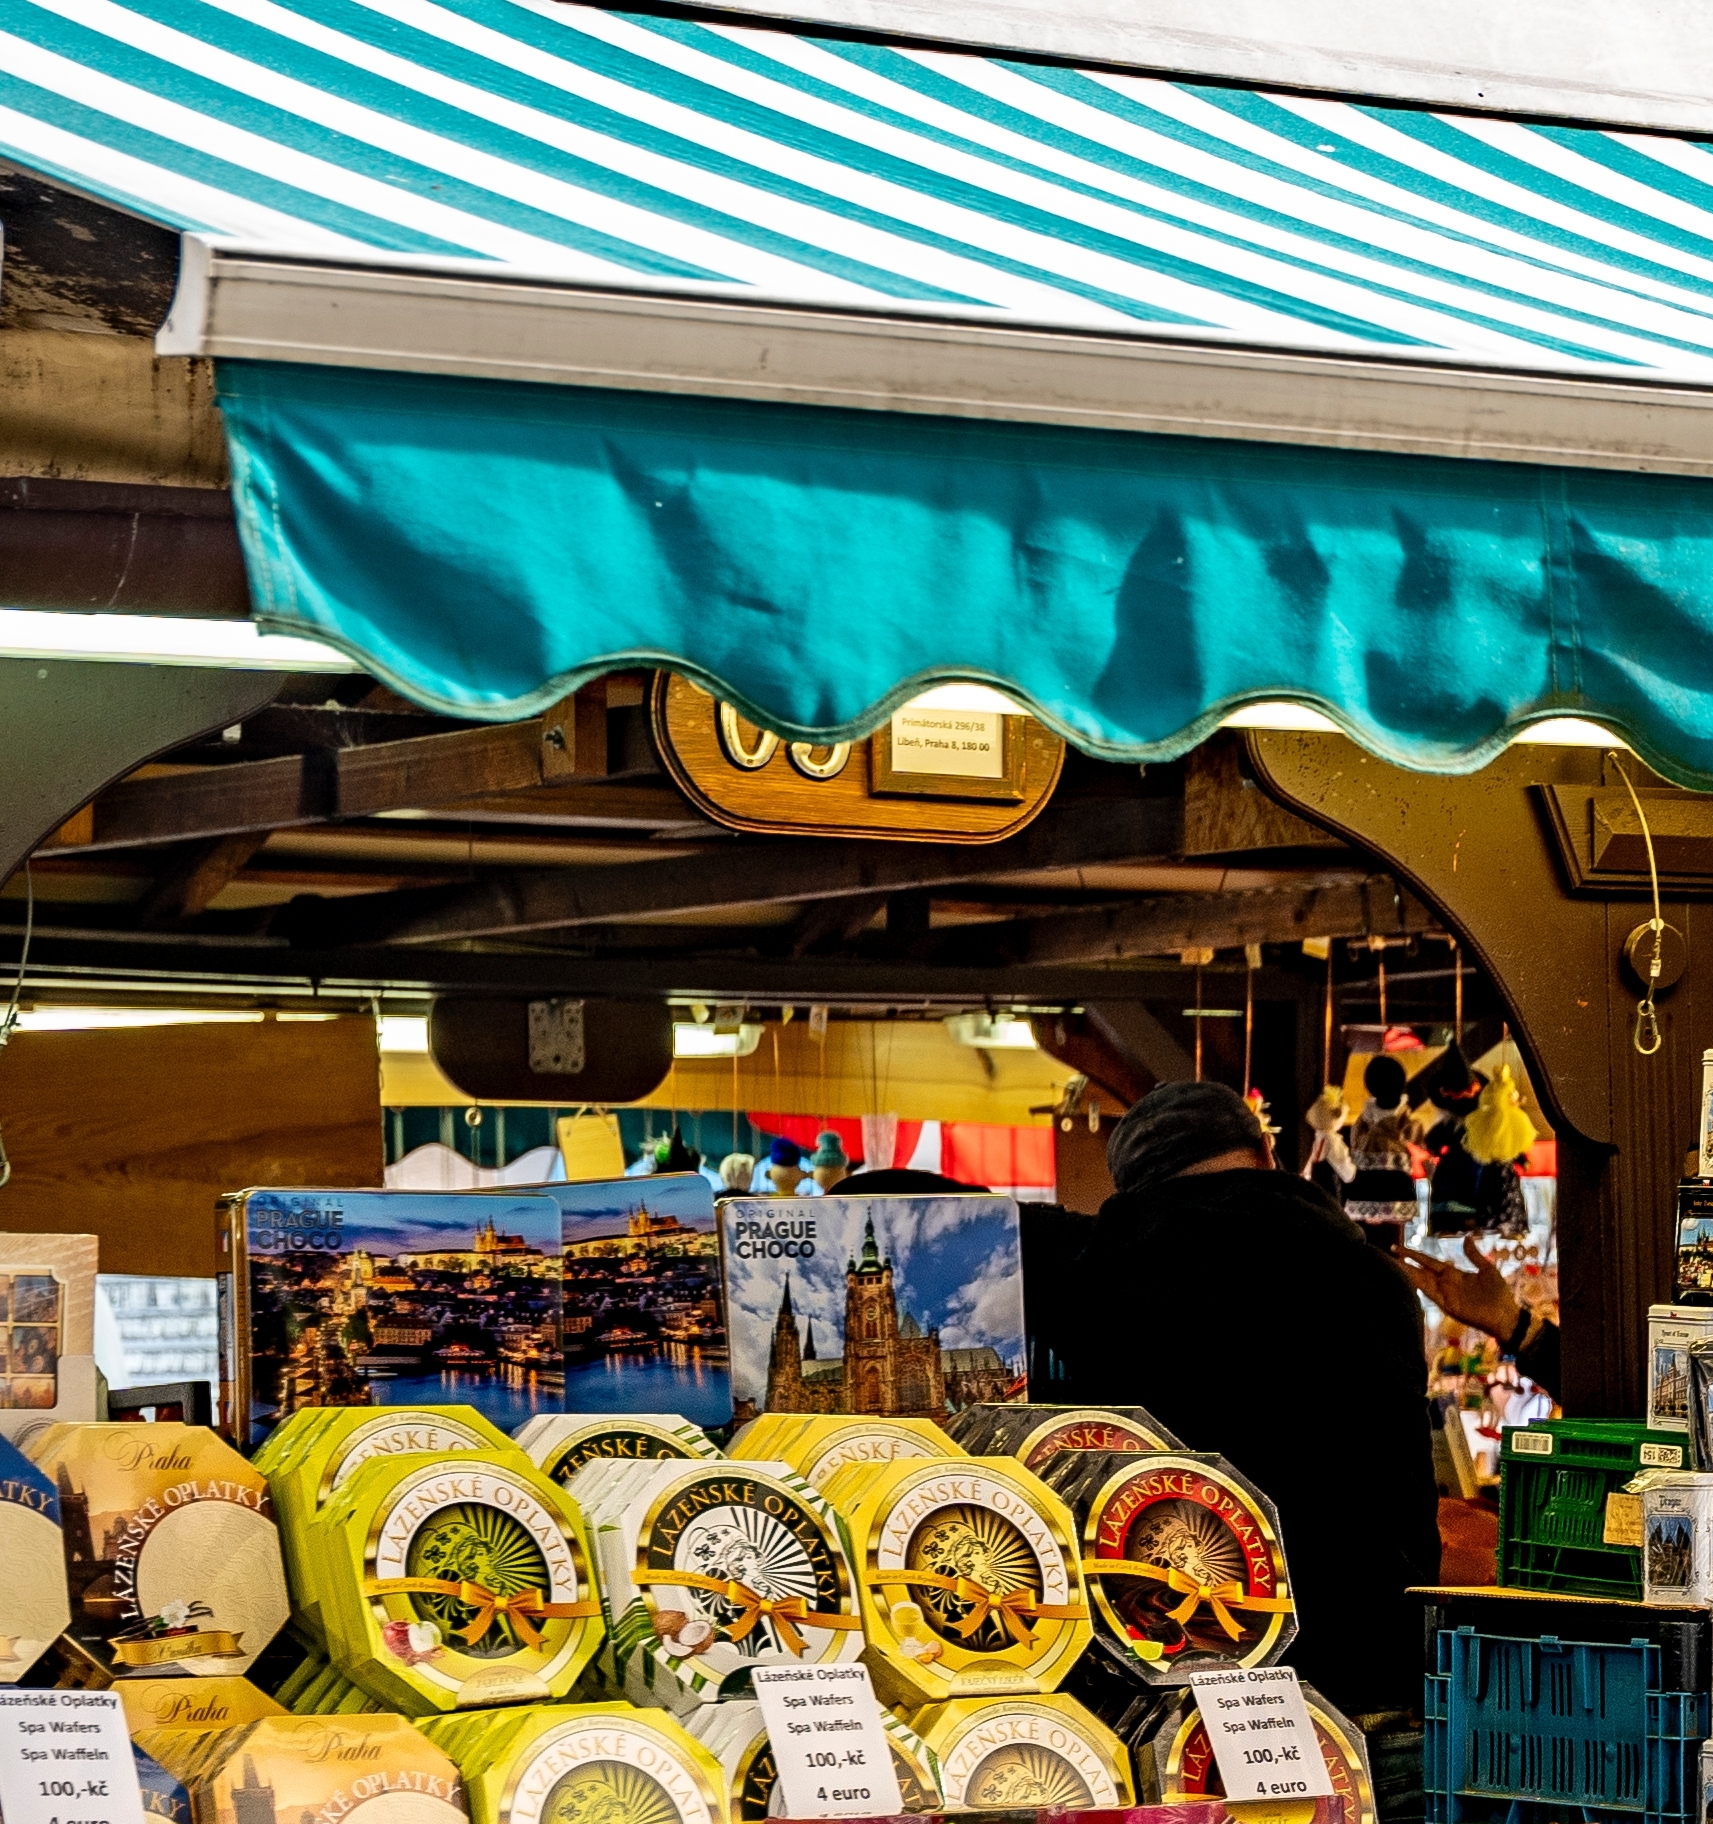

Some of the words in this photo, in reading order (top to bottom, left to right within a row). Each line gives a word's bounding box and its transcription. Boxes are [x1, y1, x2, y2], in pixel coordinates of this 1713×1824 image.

[924, 739, 948, 751] Praha
[961, 740, 977, 751] 180
[256, 1211, 344, 1230] PRAGUE
[734, 1208, 817, 1219] ORIGINAL
[256, 1231, 343, 1250] CHOCO
[735, 1220, 817, 1242] PRAGUE
[736, 1240, 816, 1260] CHOCO
[104, 1431, 194, 1473] Praha
[381, 1475, 485, 1565] LÁZEŇSKÉ
[492, 1485, 573, 1593] OPLATKY
[882, 1479, 982, 1558] LÁZEŇSKÉ
[991, 1490, 1065, 1595] OPLATKY
[1099, 1473, 1195, 1550] LÁZEŇSKÉ
[1201, 1485, 1272, 1591] OPLATKY
[110, 1498, 167, 1621] LÁZEŇSKÉ
[162, 1480, 271, 1514] OPLATKY
[652, 1482, 756, 1557] LÁZEŇSKÉ
[764, 1494, 836, 1603] OPLATKY
[757, 1669, 815, 1683] Lázeňské
[816, 1668, 865, 1683] Oplatky
[1190, 1672, 1245, 1687] Lázeňské
[1246, 1669, 1294, 1684] Oplatky
[0, 1693, 59, 1710] ázeňské
[60, 1694, 118, 1711] Oplatky
[783, 1696, 807, 1709] Spa
[808, 1694, 854, 1707] Wafers
[1217, 1695, 1241, 1710] Spa
[1242, 1693, 1285, 1706] Wafers
[18, 1719, 49, 1738] Spa
[50, 1719, 102, 1735] Wafers
[787, 1722, 812, 1736] Spa
[813, 1720, 863, 1733] Waffeln
[1222, 1720, 1248, 1734] Spa
[1250, 1717, 1296, 1731] Waffeln
[20, 1746, 49, 1764] Spa
[51, 1746, 110, 1762] Waffeln
[805, 1749, 867, 1769] 100,-kč
[945, 1719, 1041, 1799] LÁZEŇSKÉ
[1047, 1723, 1114, 1797] OPLAT
[1243, 1746, 1301, 1766] 100,-kč
[515, 1733, 628, 1820] LÁZEŇSKÉ
[39, 1779, 110, 1799] 100,-kč
[351, 1771, 462, 1803] OPLATKY
[816, 1786, 829, 1801] 4
[832, 1787, 871, 1802] euro
[1256, 1781, 1267, 1796] 4
[1269, 1779, 1307, 1795] euro
